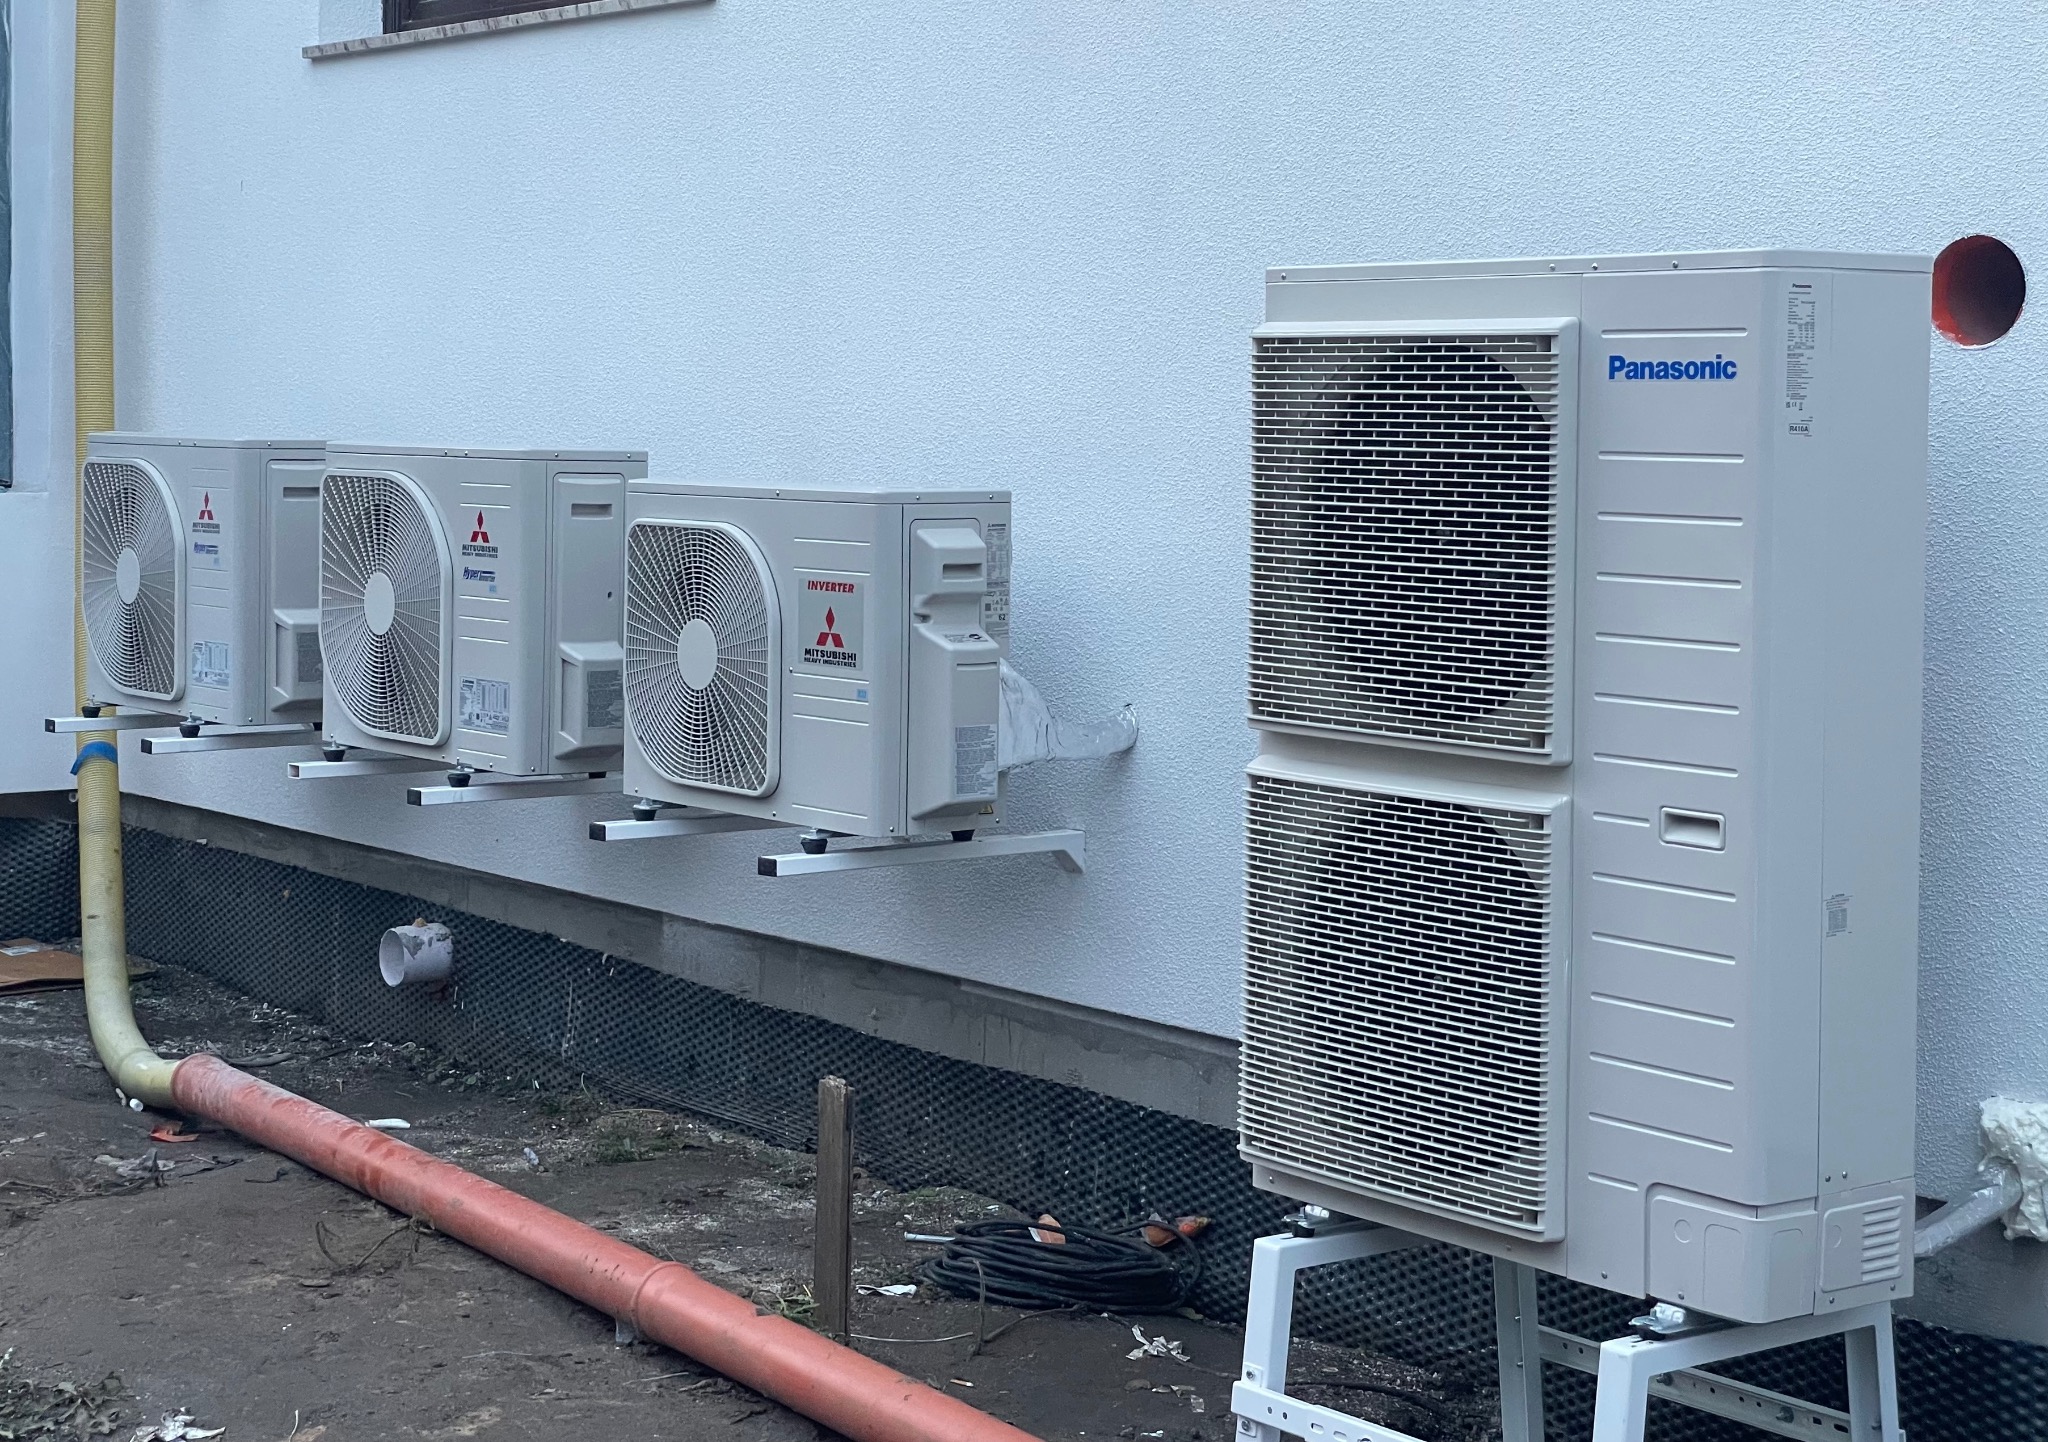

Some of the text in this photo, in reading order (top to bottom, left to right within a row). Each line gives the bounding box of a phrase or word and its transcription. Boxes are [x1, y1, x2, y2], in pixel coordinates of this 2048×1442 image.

[1609, 354, 1737, 380] Panasonic
[462, 544, 498, 554] MITSUBISHI
[808, 580, 855, 593] INVERTER
[804, 648, 857, 662] MITSUBISHI
[803, 657, 857, 668] HEAVY INDUSTRIES
